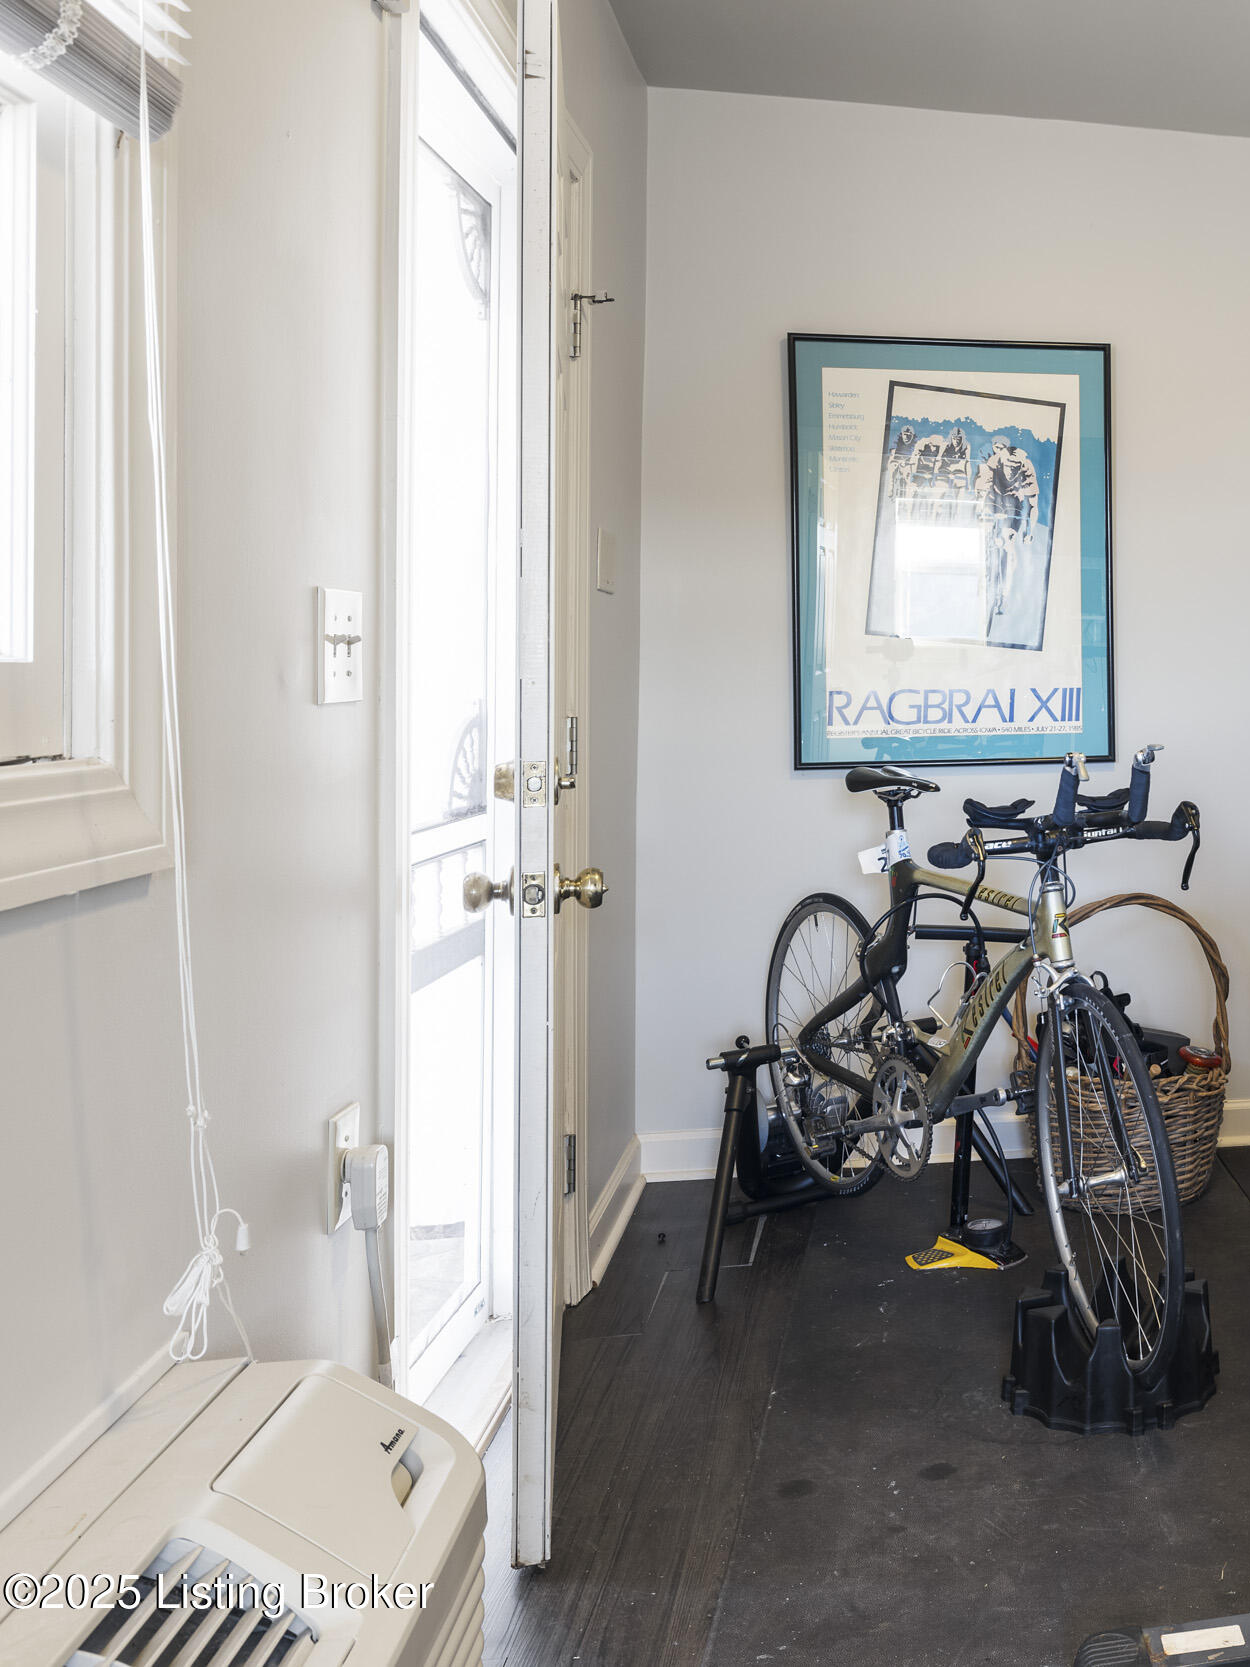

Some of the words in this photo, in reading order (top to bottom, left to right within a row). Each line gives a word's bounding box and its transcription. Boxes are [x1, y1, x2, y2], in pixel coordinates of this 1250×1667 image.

[827, 687, 1016, 727] RAGBRAI
[1027, 687, 1083, 723] XIII
[984, 840, 1013, 850] ace
[380, 1428, 405, 1455] Amana
